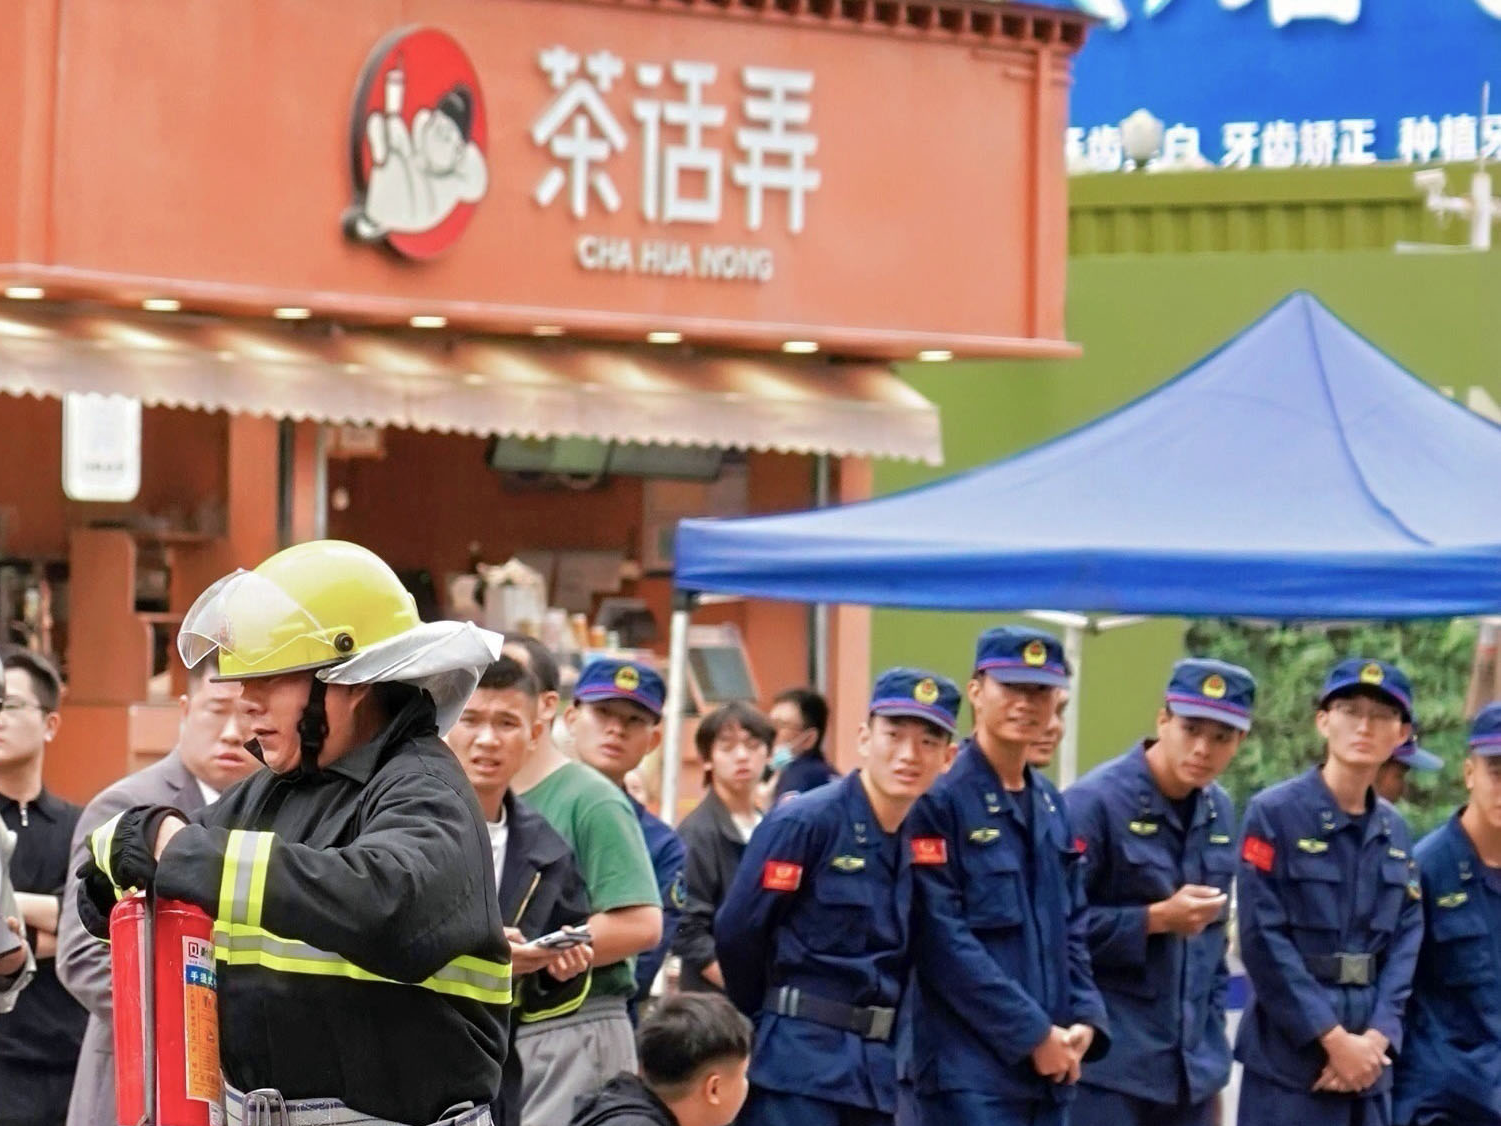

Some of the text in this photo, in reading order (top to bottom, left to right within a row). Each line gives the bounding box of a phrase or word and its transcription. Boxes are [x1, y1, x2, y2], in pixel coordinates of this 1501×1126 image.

[531, 46, 823, 235] 茶话弄
[1221, 118, 1376, 168] 牙齿矫正
[577, 236, 775, 282] CHA HUA NONG
